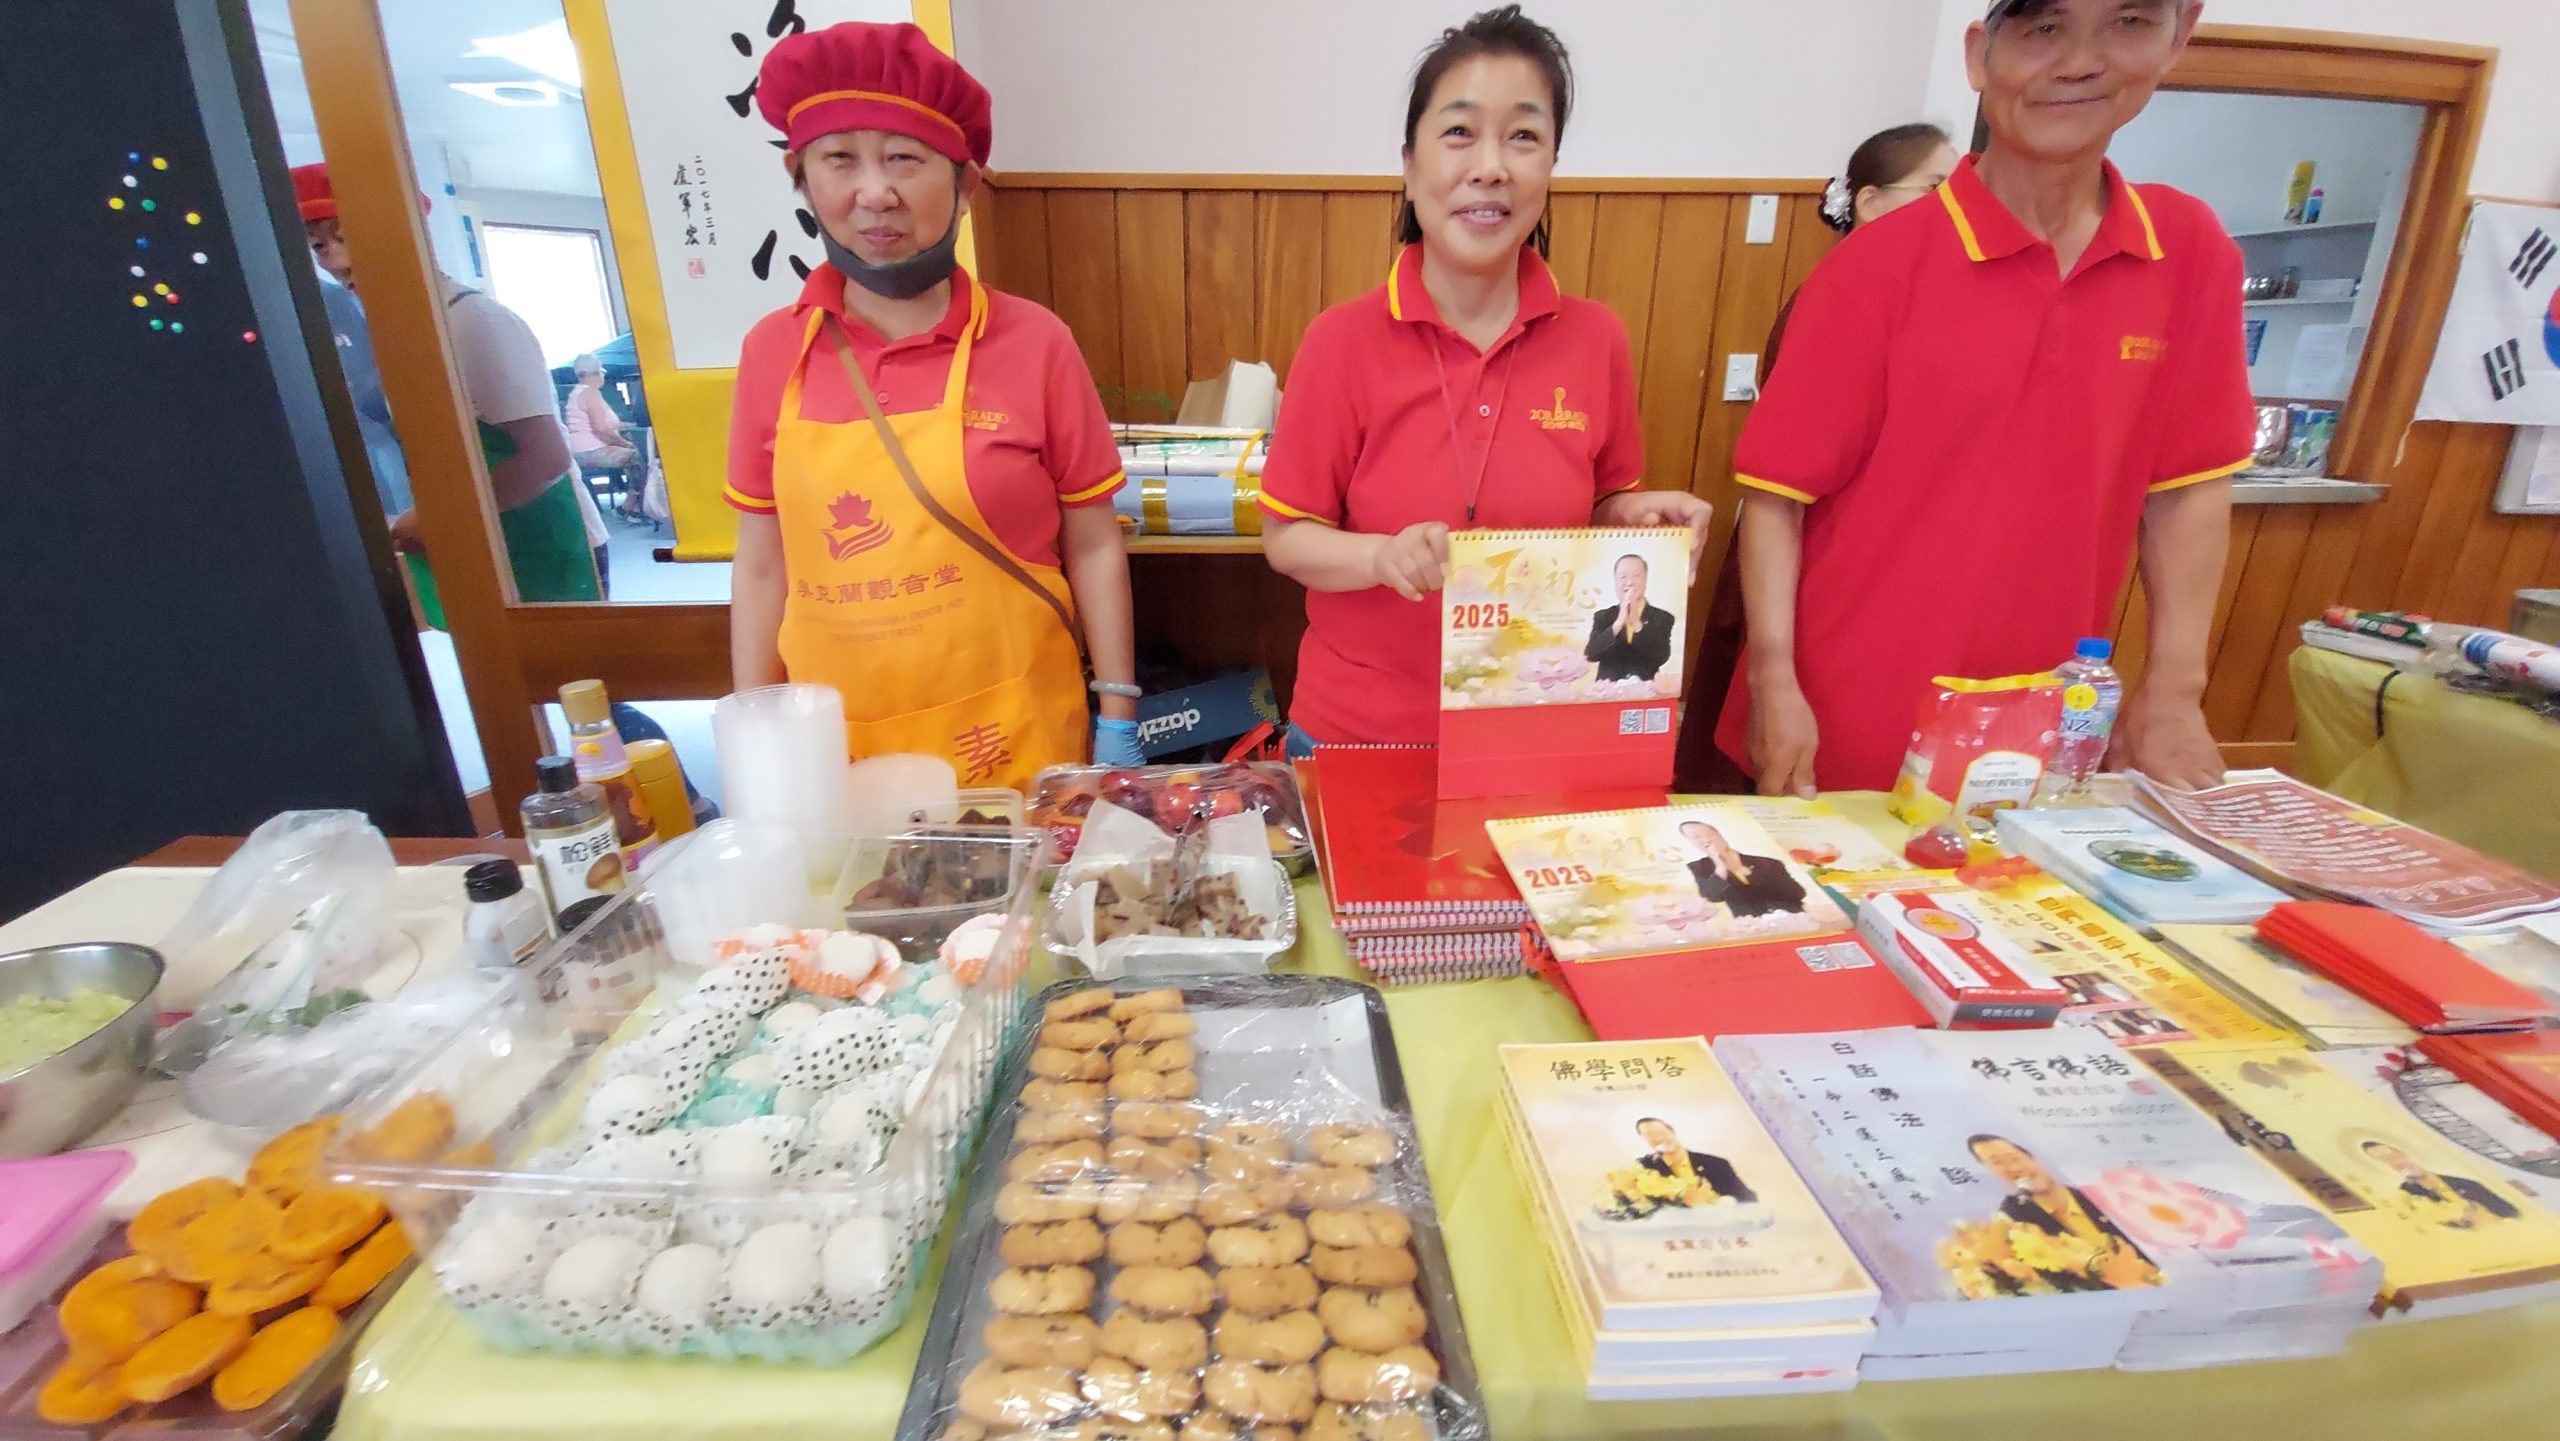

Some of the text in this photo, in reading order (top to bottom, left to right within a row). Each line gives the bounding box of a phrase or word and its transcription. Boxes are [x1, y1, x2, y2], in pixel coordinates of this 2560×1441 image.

[1452, 603, 1511, 629] 2025
[954, 721, 1013, 785] 素
[1524, 865, 1593, 889] 2025
[1549, 1055, 1687, 1082] 佛學問答
